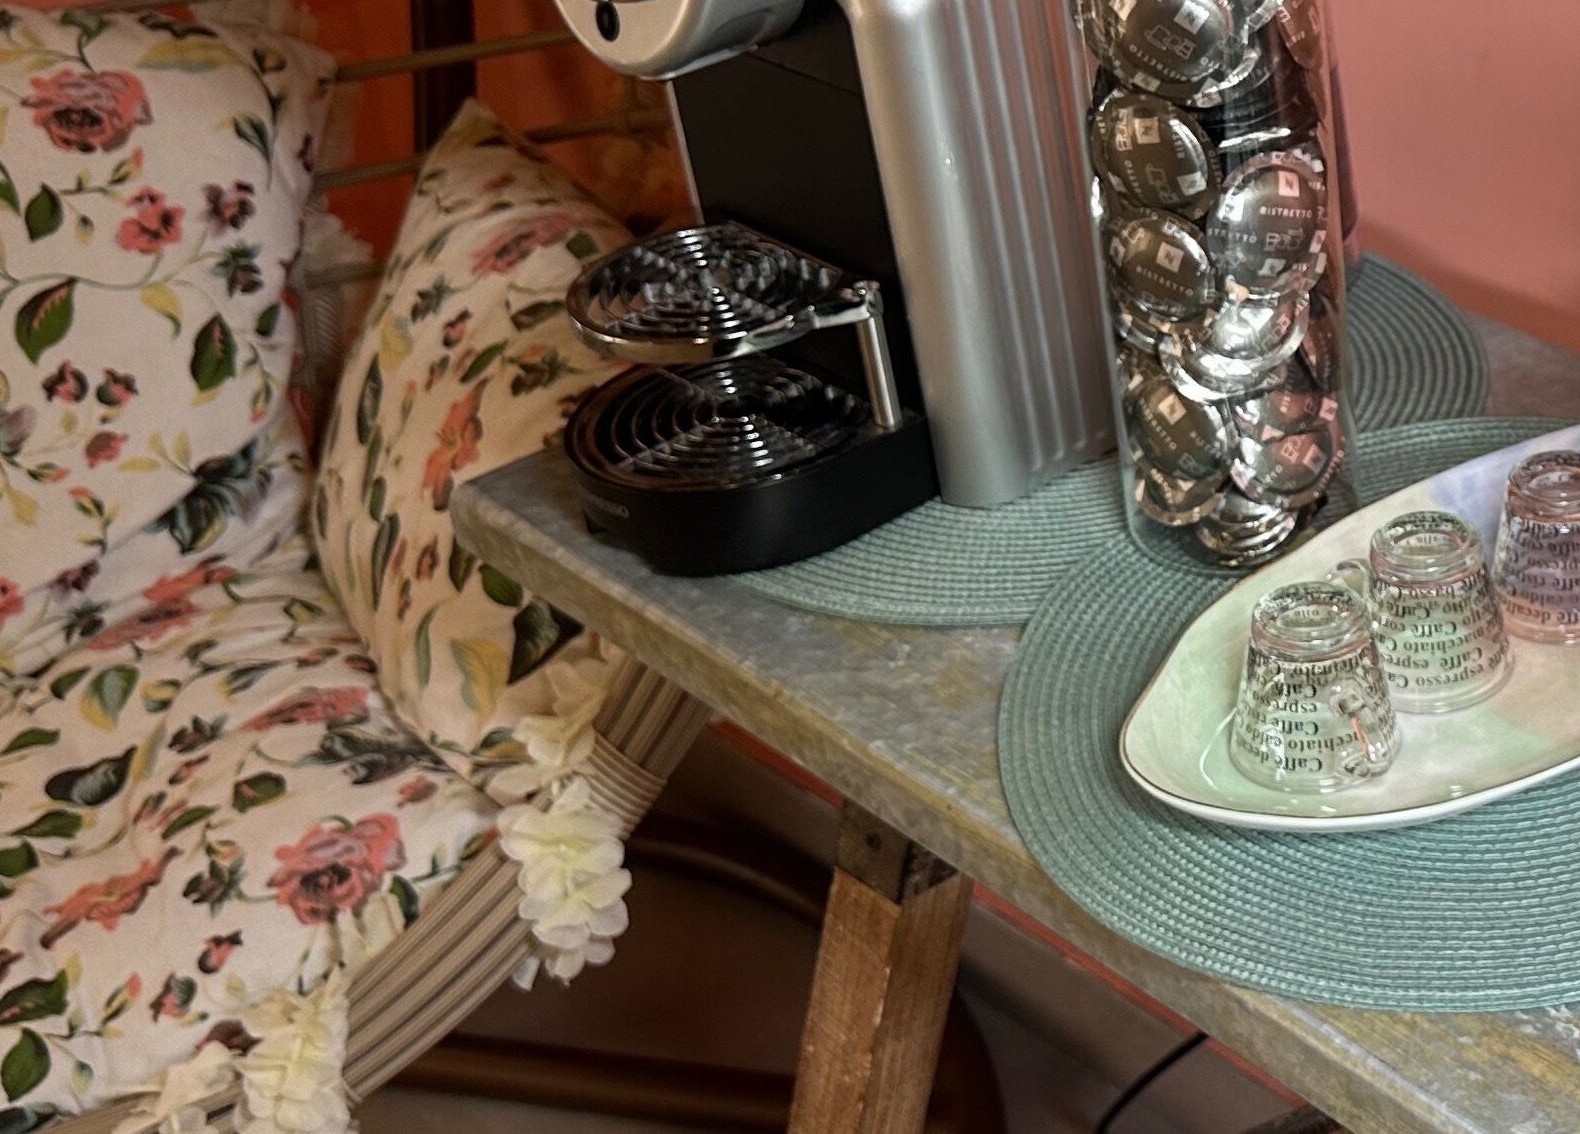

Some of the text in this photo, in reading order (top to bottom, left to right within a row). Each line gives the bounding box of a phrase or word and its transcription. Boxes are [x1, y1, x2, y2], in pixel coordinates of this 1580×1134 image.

[1259, 205, 1313, 219] RISTRETTO
[1135, 265, 1194, 298] RISTRETTO
[1440, 646, 1483, 670] Caffè
[1416, 663, 1484, 687] espresso
